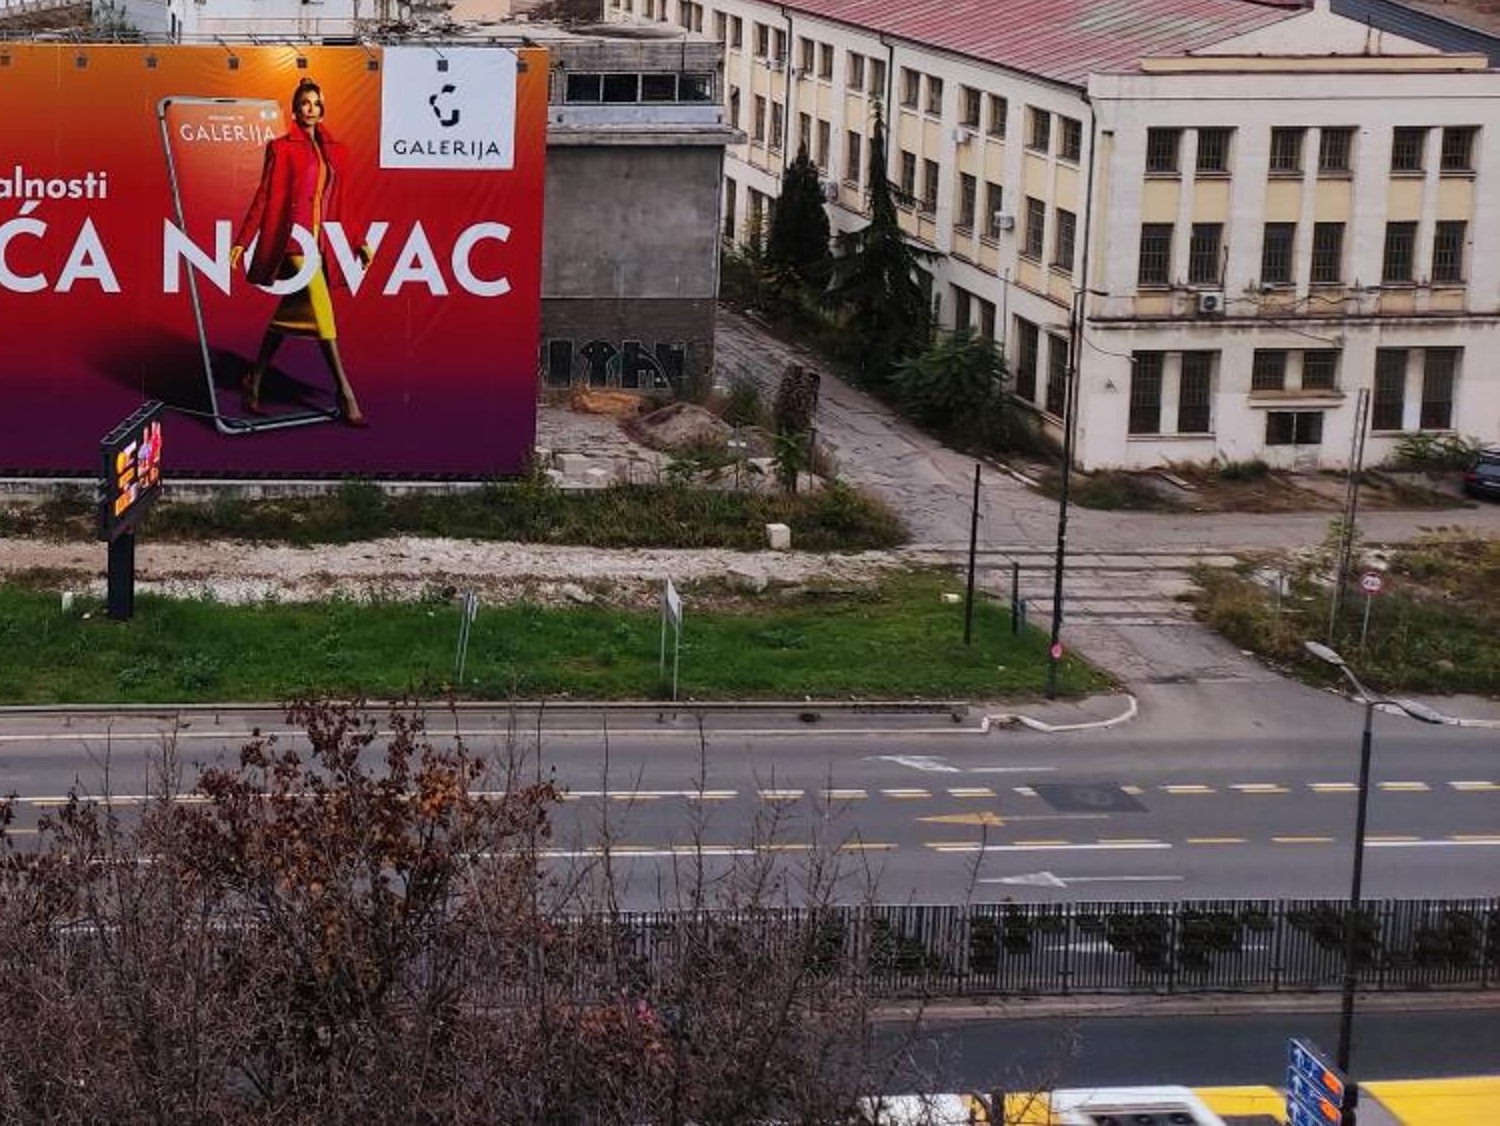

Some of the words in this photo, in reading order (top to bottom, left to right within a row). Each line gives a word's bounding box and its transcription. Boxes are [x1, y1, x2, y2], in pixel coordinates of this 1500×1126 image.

[180, 123, 275, 146] GALERIJA
[393, 139, 501, 160] GALERIJA
[163, 218, 512, 297] NOVAC
